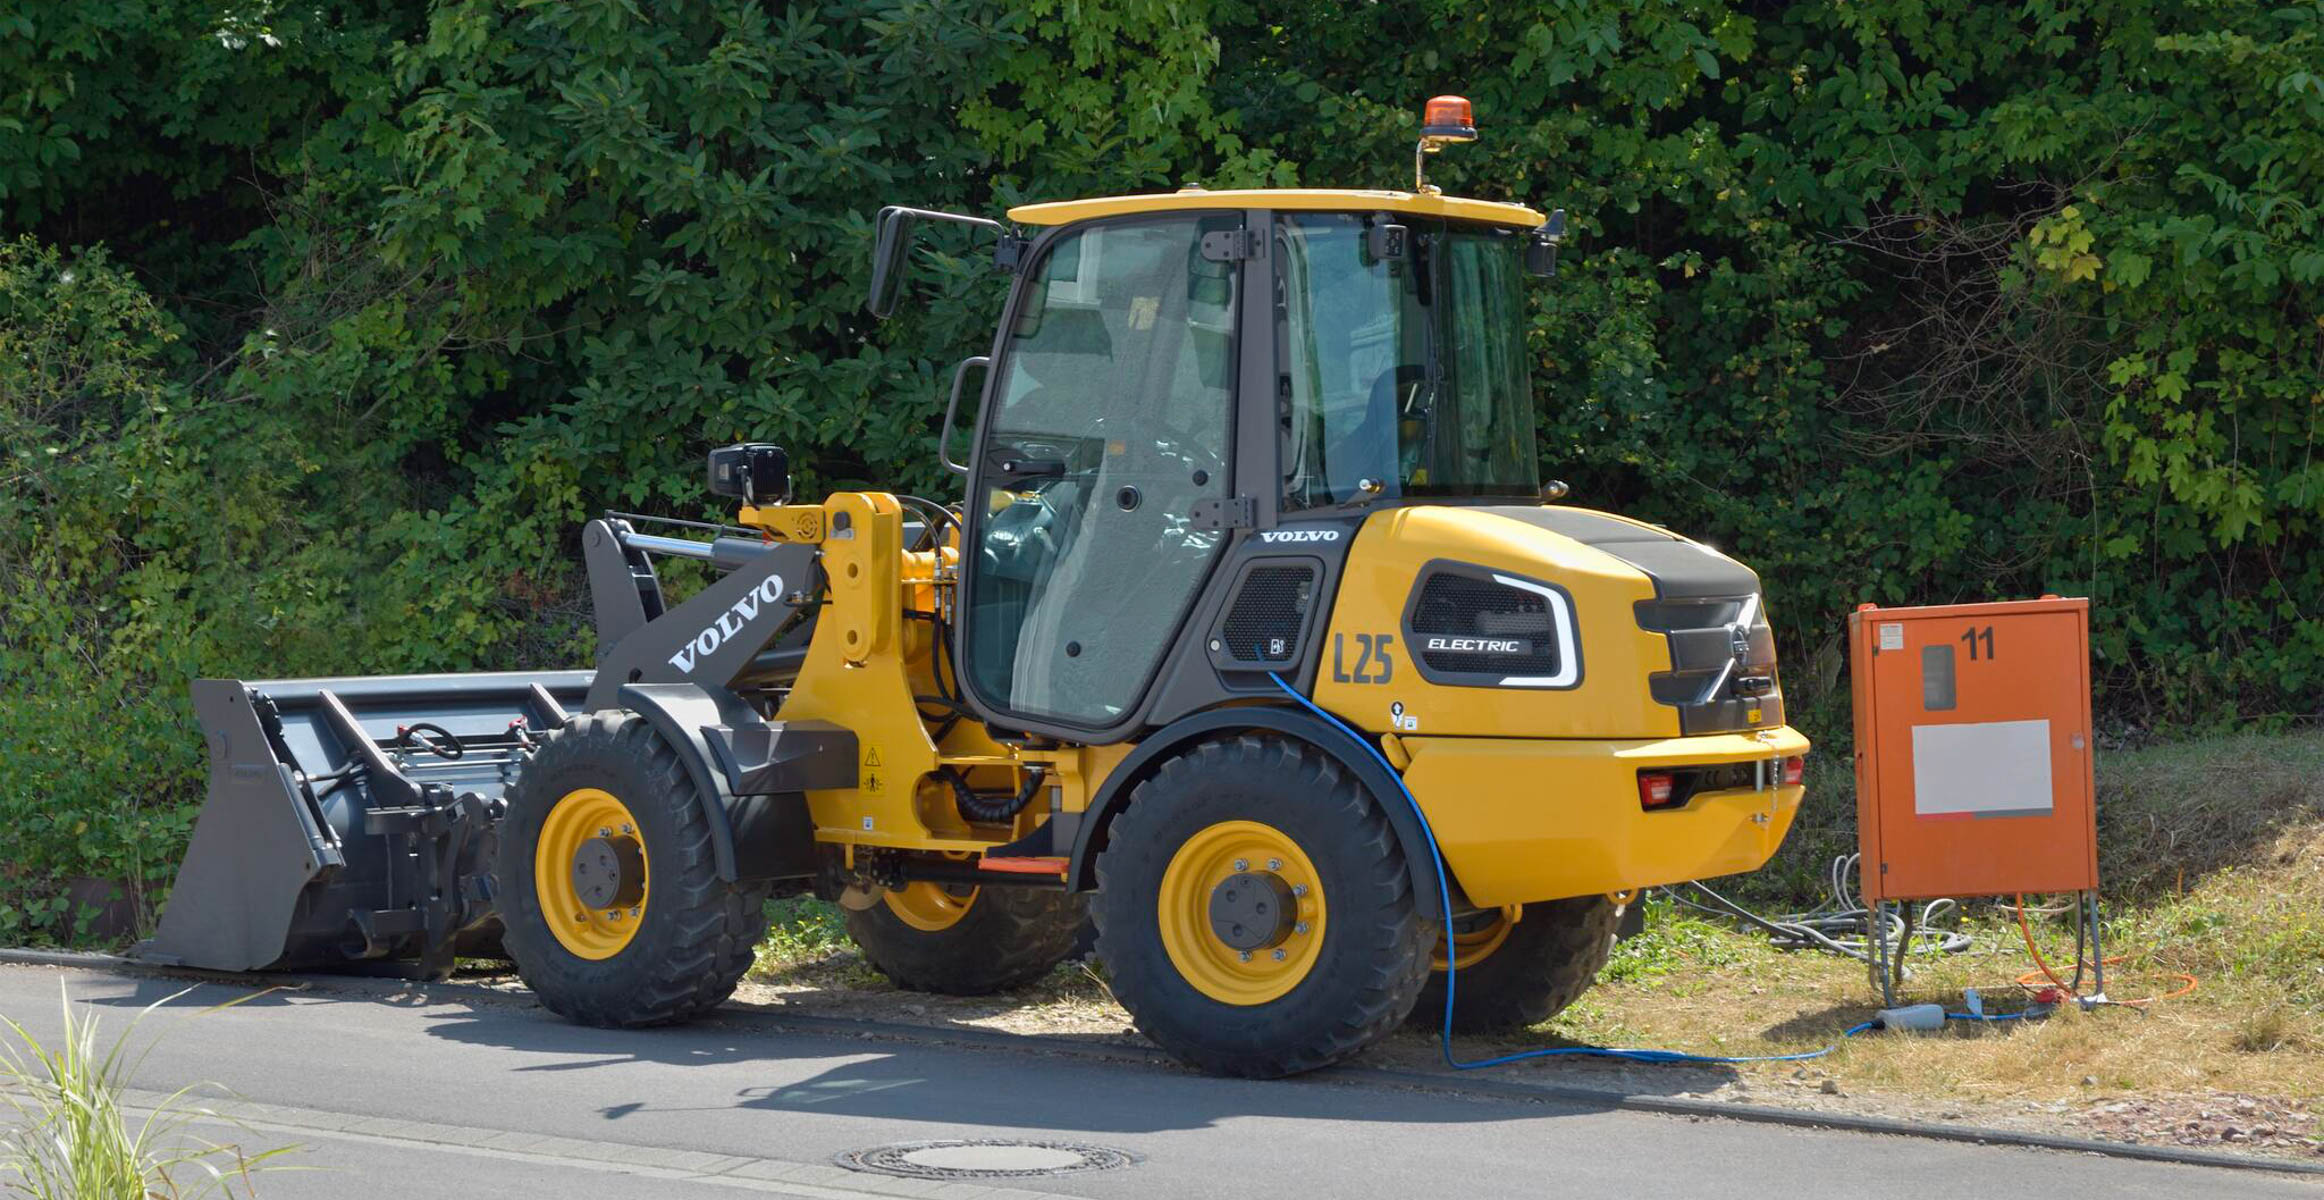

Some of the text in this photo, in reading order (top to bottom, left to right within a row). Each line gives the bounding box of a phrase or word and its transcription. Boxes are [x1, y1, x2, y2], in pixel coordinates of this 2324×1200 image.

[1260, 530, 1339, 543] VOLVO
[668, 574, 784, 673] VOLVO
[1333, 633, 1394, 684] L25
[1428, 638, 1520, 652] ELECTRIC
[1961, 626, 1994, 661] 11
